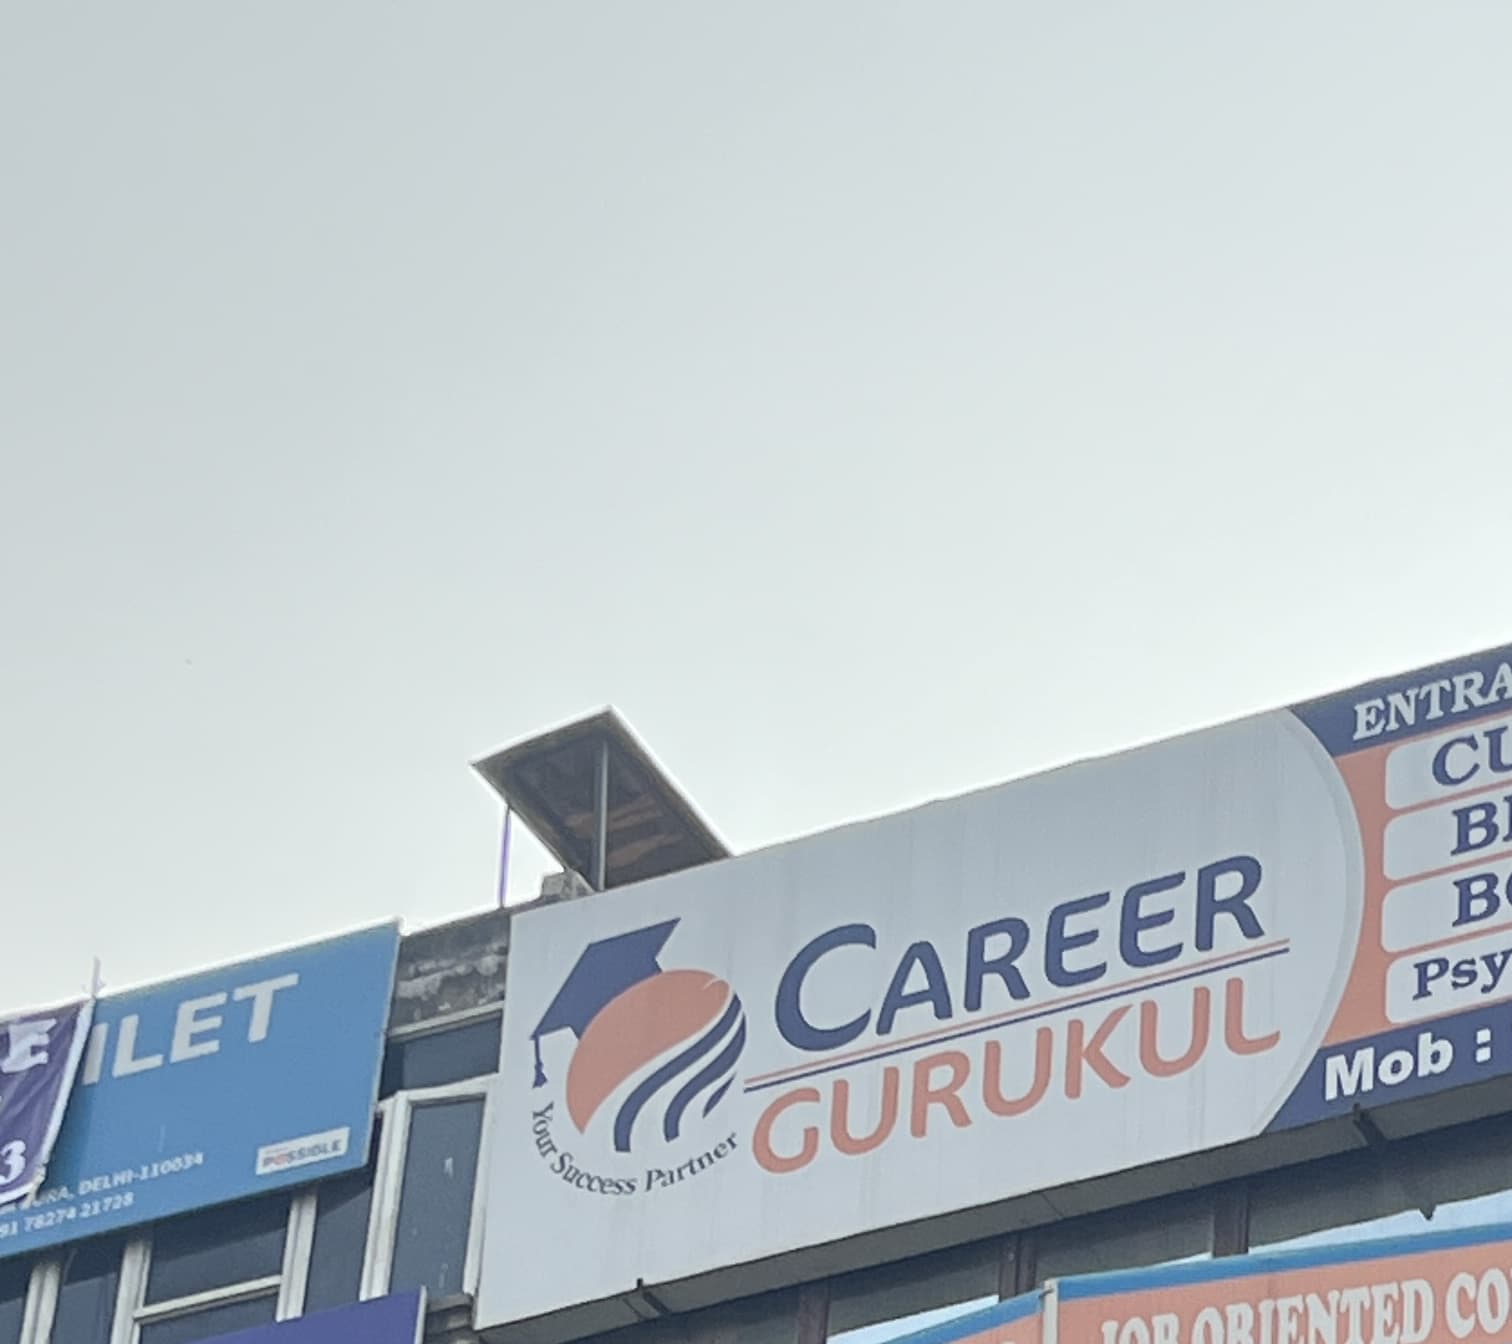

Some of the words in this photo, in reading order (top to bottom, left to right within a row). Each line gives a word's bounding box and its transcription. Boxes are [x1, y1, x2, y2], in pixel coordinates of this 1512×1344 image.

[774, 855, 1265, 1052] CAREER
[751, 977, 1281, 1175] GURUKUL
[1322, 1031, 1455, 1101] Mob
[532, 1101, 557, 1158] Your
[550, 1151, 637, 1195] Success
[644, 1132, 738, 1192] Partner
